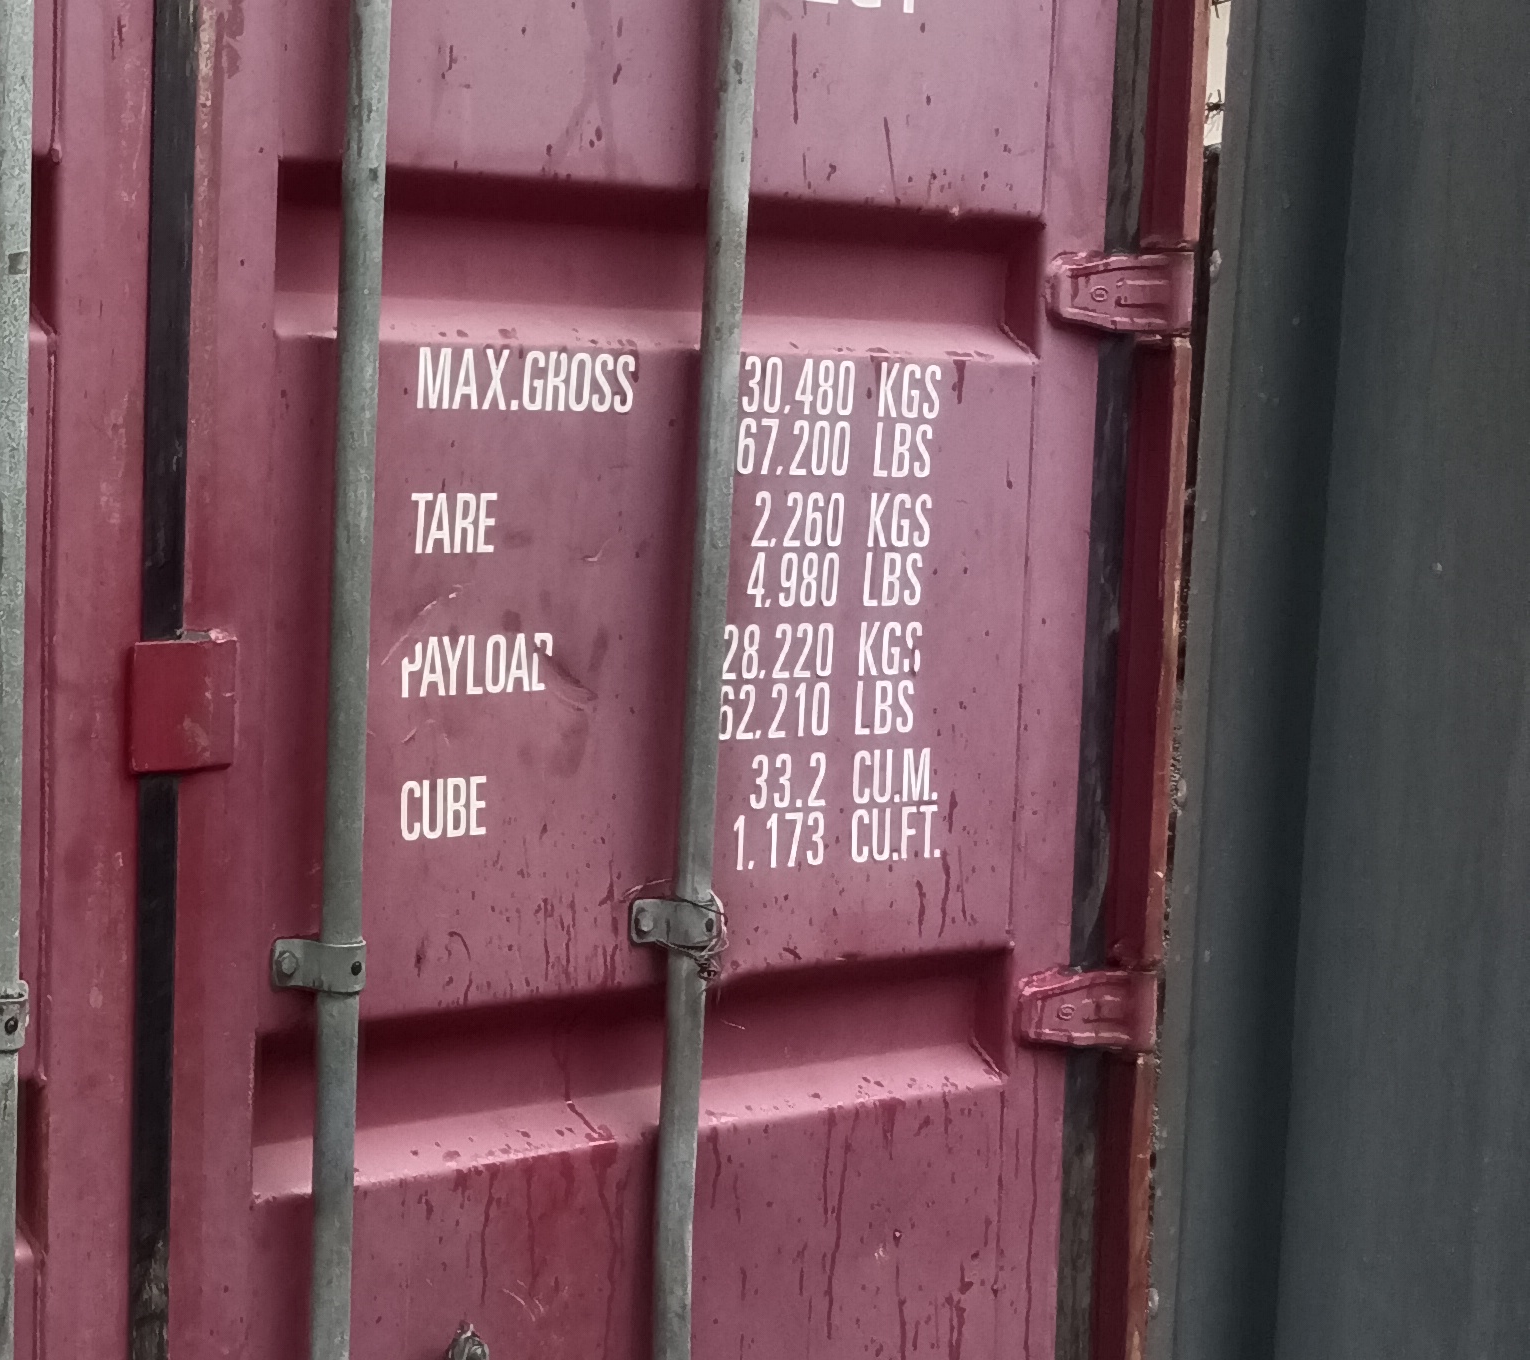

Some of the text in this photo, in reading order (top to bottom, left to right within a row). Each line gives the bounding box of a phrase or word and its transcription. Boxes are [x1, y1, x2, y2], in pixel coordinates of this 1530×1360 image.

[416, 346, 942, 420] MAX.GROSS 30,480 KGS
[736, 417, 933, 478] 67,200 LBS
[410, 490, 933, 554] TARE 2,260 KGS
[746, 551, 923, 608] 4,980 LBS
[721, 622, 834, 680] 28,220
[858, 621, 923, 677] KGS
[718, 679, 915, 741] 62,210 LBS
[400, 747, 939, 841] CUBE 33.2 CU.M.
[733, 804, 941, 871] 1,173 CU.FT.
